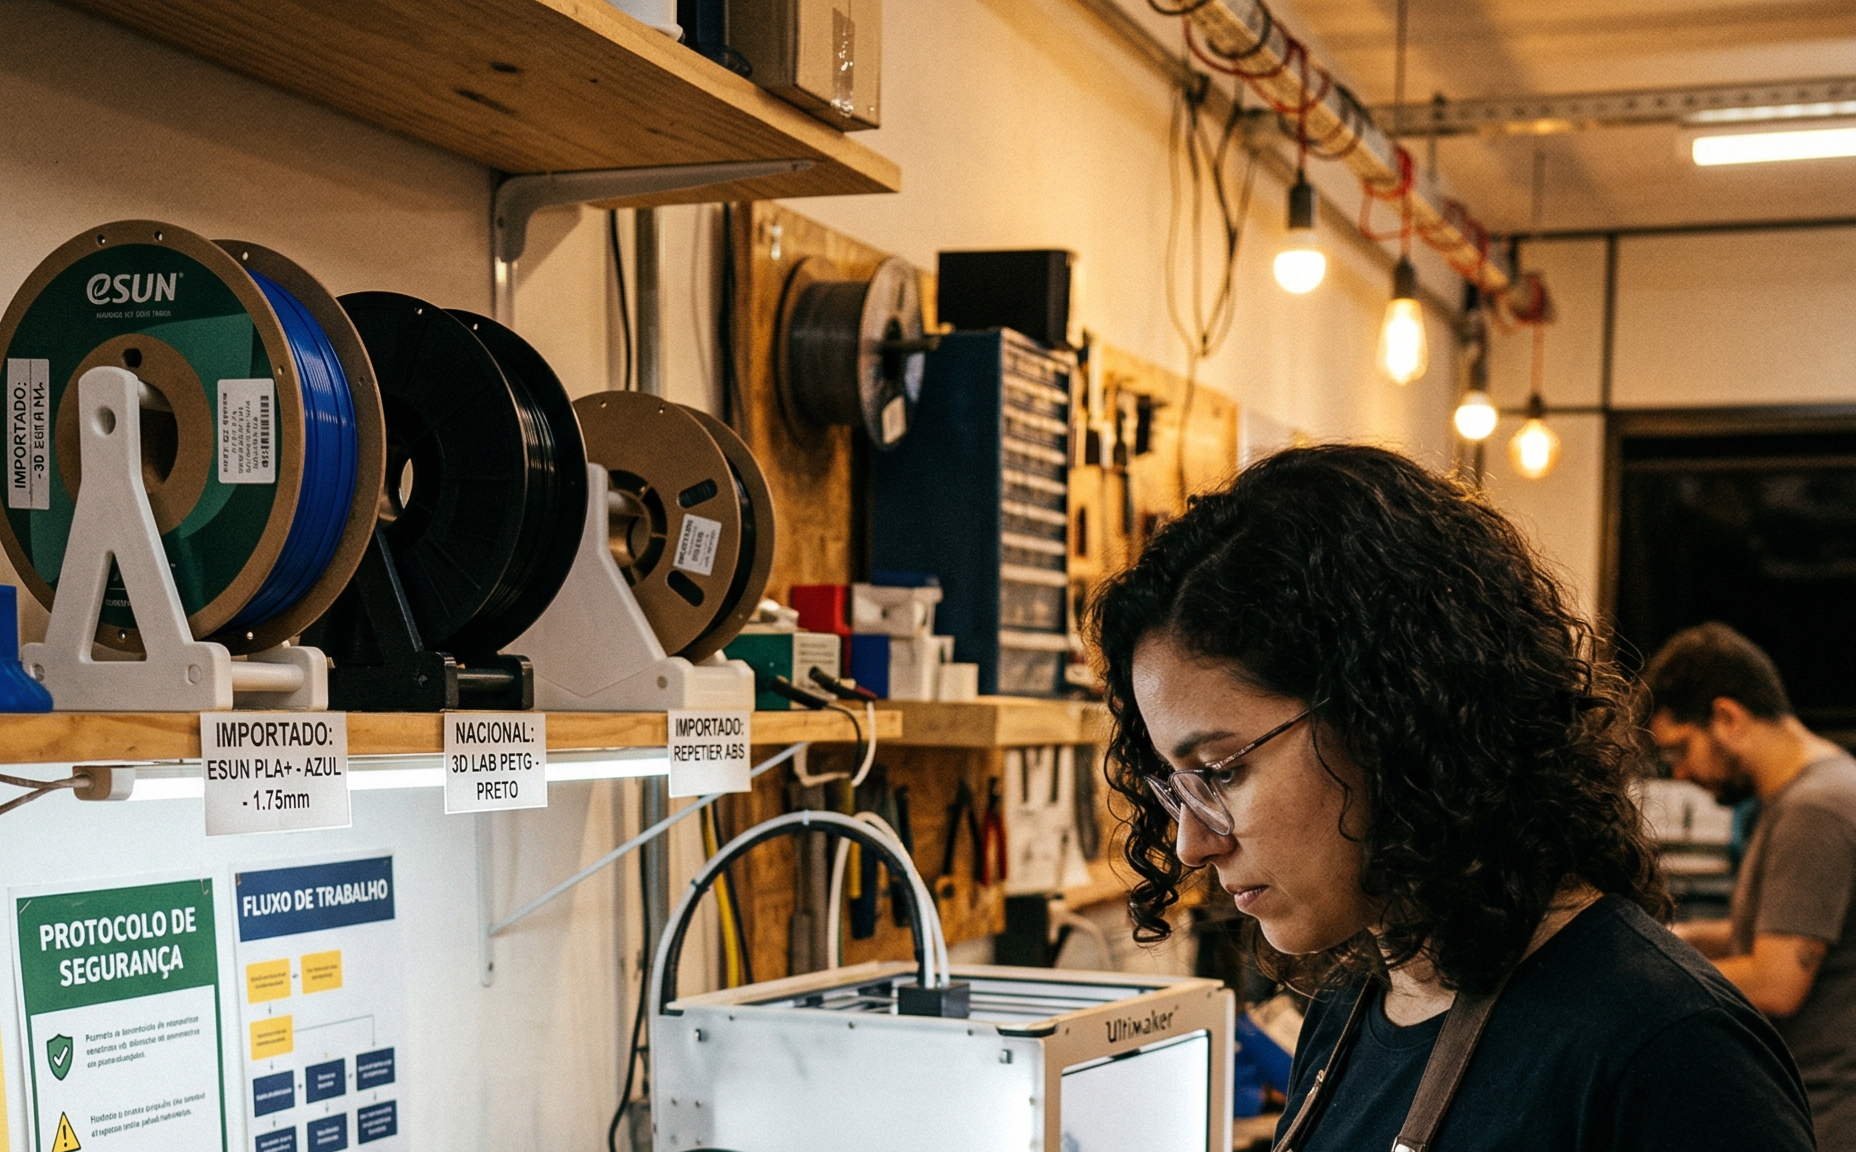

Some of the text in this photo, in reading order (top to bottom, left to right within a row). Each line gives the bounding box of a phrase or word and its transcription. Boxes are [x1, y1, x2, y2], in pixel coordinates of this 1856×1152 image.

[13, 382, 27, 489] IMPORTADO:
[216, 721, 333, 748] IMPORTADO:
[455, 721, 534, 744] NACIONAL:
[675, 717, 744, 737] IMPORTADO:
[452, 754, 468, 773] 3D
[472, 753, 497, 772] LAB
[500, 752, 532, 771] PETG
[674, 743, 745, 761] REPETIER ABS
[207, 758, 250, 780] ESUN
[255, 758, 292, 779] PLA+
[304, 756, 342, 777] AZUL
[253, 789, 310, 810] 1.75mm
[476, 780, 519, 800] PRETO
[243, 878, 388, 917] FLUXO DE TRABALHO
[39, 906, 197, 951] PROTOCOLO DE
[59, 944, 184, 987] SEGURANÇA
